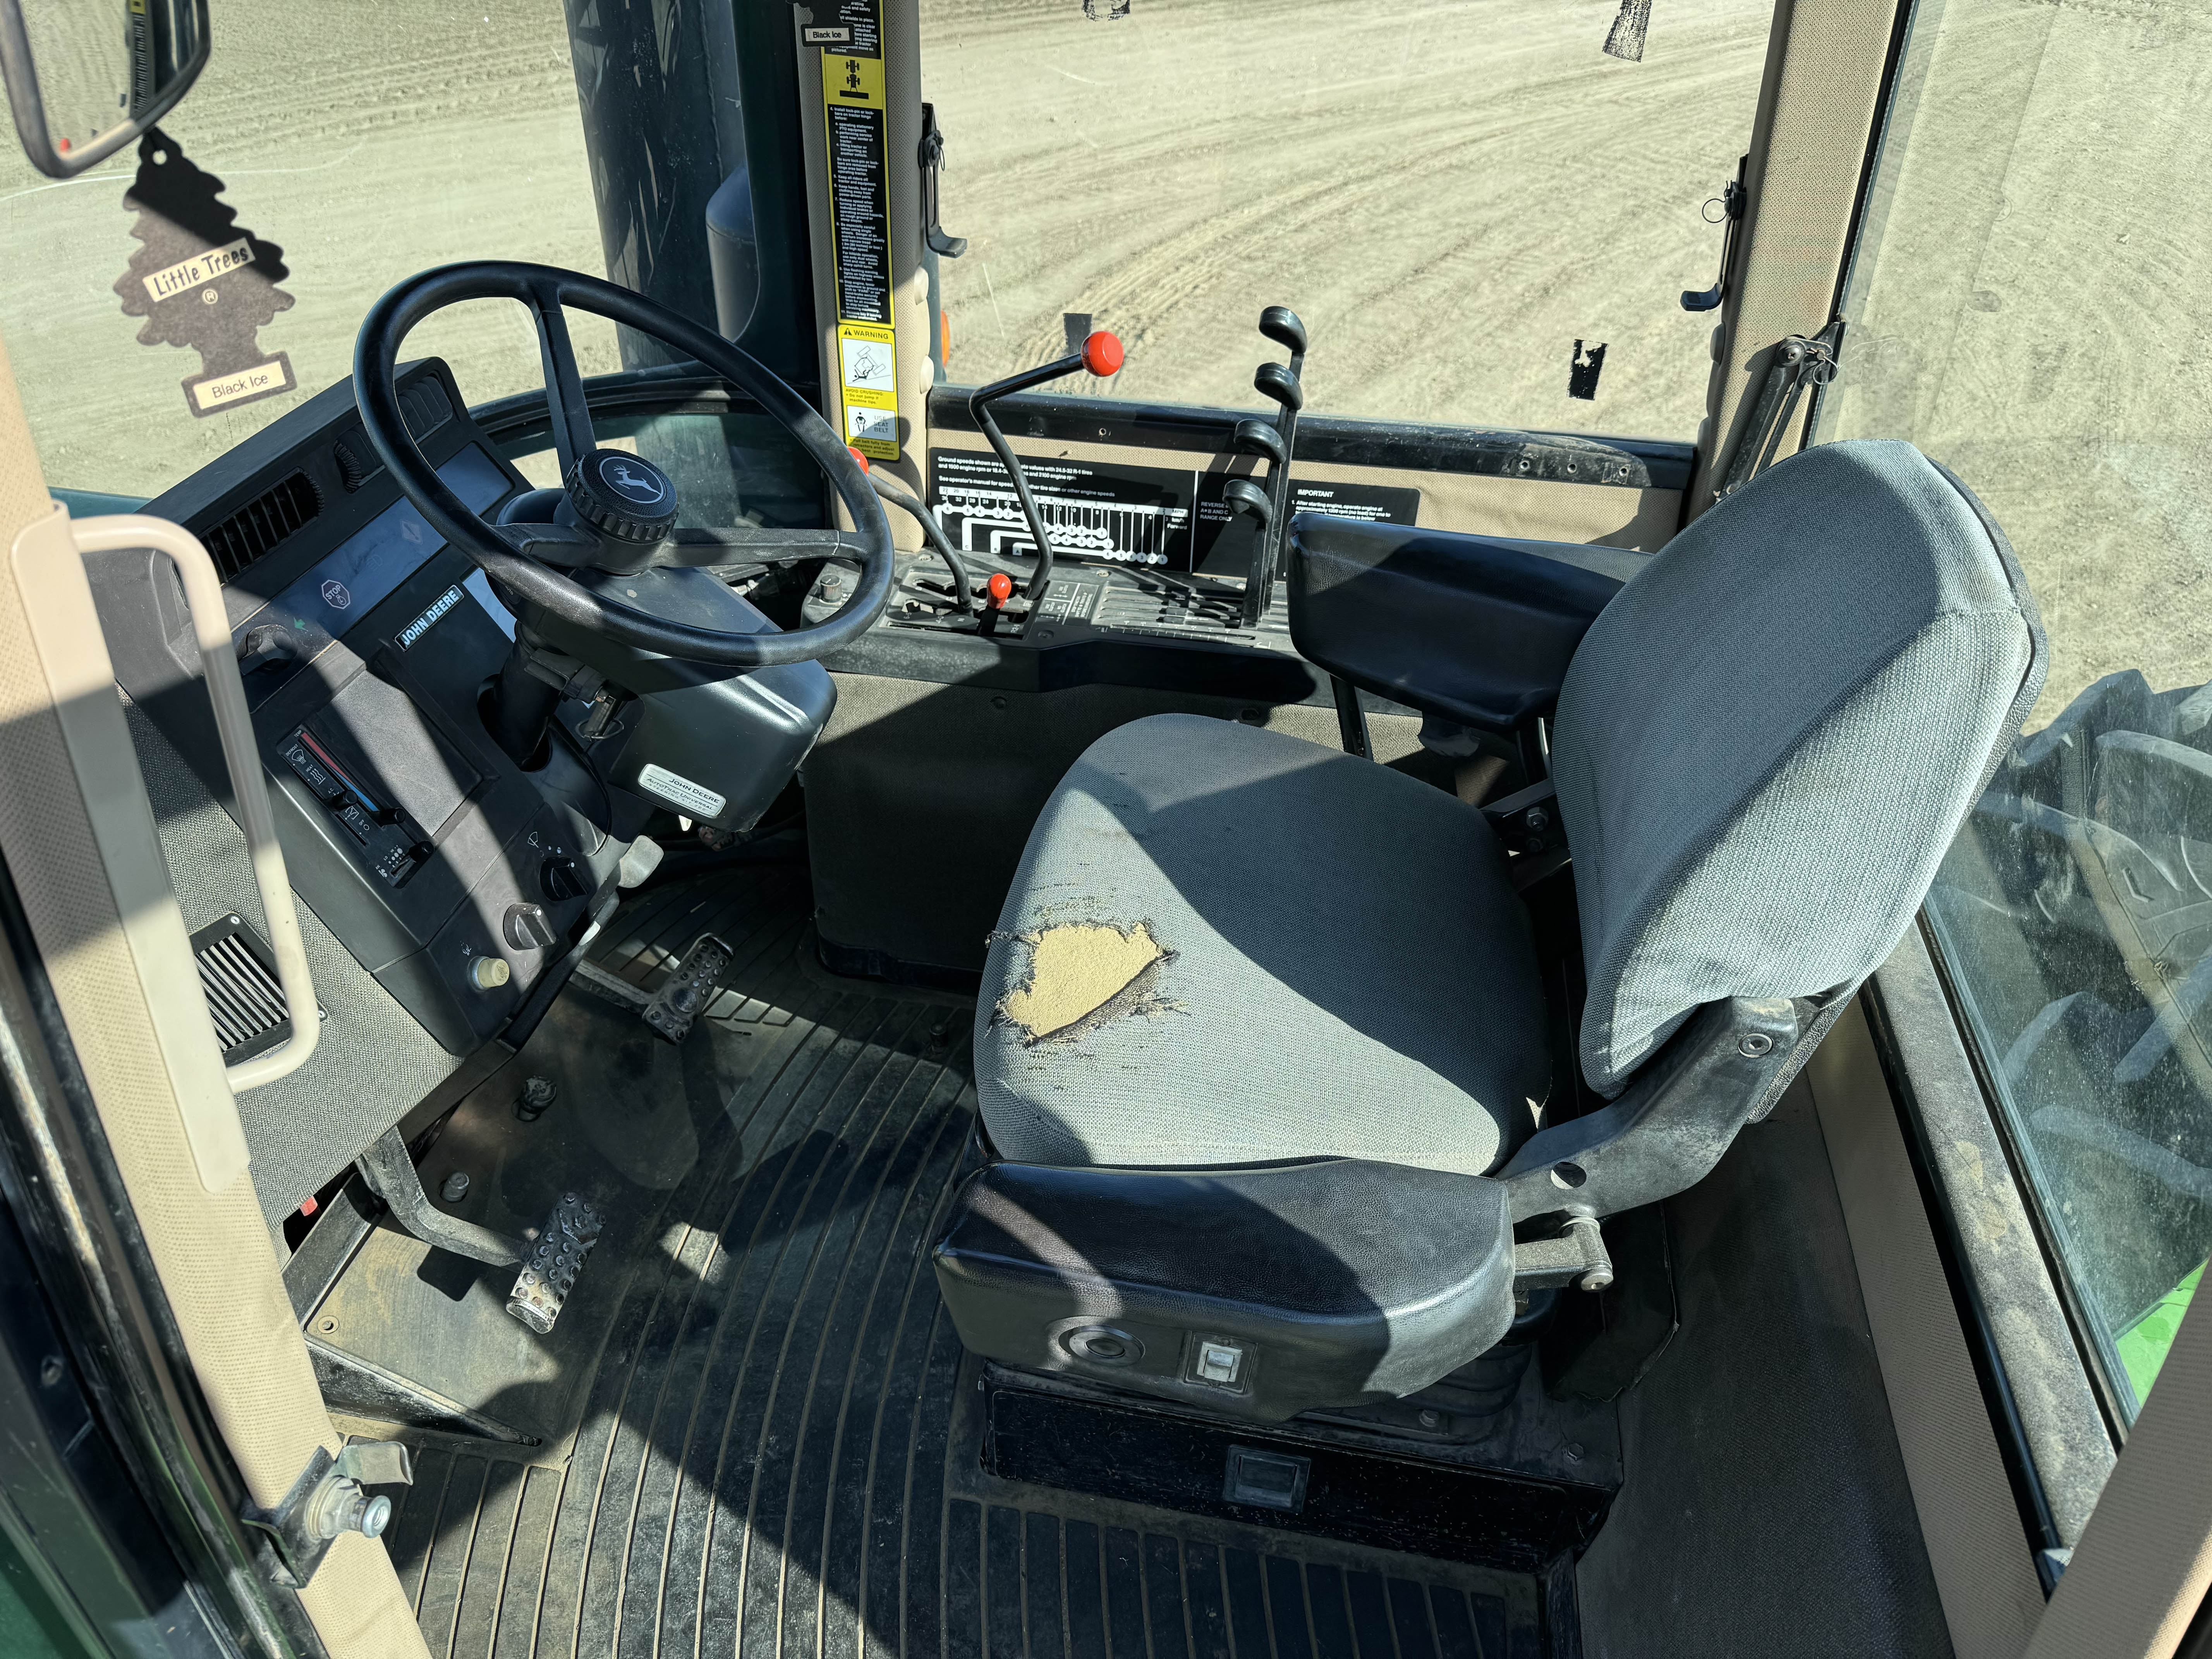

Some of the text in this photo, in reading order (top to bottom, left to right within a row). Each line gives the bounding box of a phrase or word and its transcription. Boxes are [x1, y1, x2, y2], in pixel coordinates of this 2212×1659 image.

[154, 246, 249, 297] Little Trees
[854, 330, 888, 339] WARNING
[211, 373, 268, 399] Black Ice
[1297, 489, 1334, 498] IMPORTANT
[325, 585, 341, 599] STOP
[401, 589, 460, 646] JOHN DEERE
[285, 744, 299, 756] DEFROST
[646, 778, 713, 811] AUTOTRAC UNIVERSAL
[649, 783, 679, 799] STEERING
[669, 778, 720, 804] JOHN DEERE
